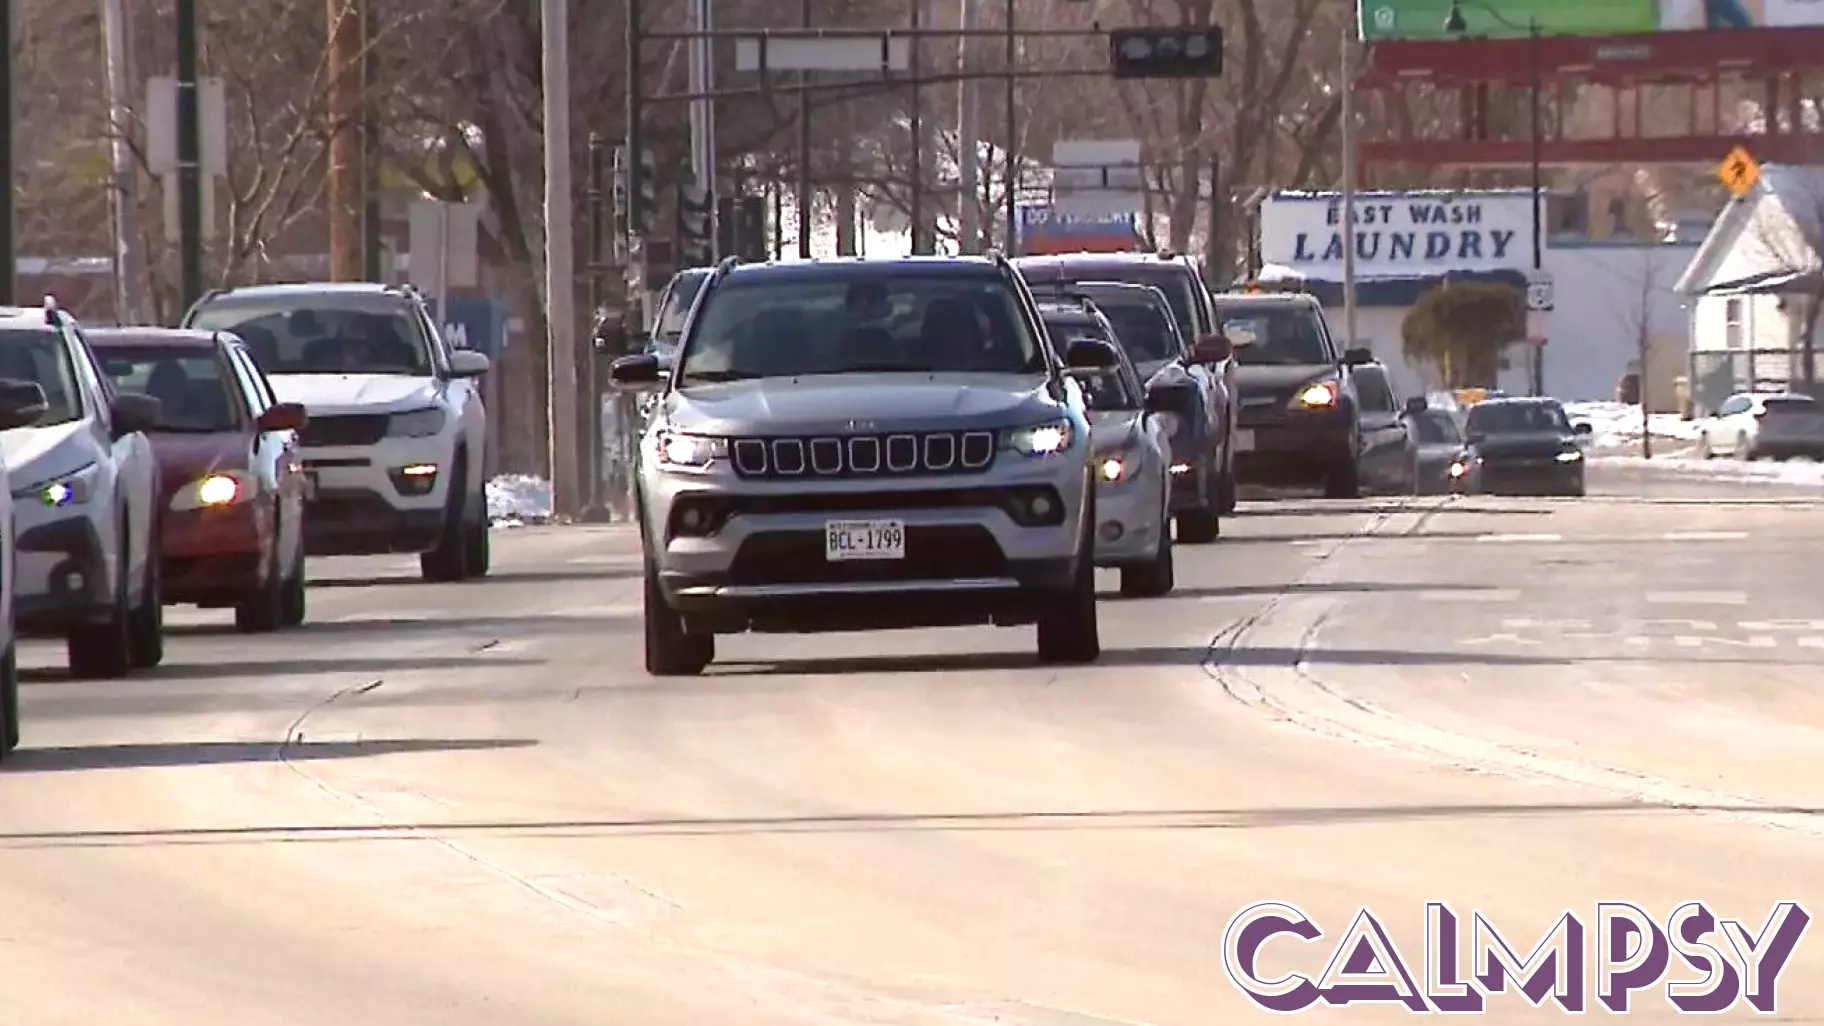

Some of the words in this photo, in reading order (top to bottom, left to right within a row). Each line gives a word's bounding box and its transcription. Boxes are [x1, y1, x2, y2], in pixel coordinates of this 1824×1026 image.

[1409, 204, 1482, 225] WASH
[1293, 229, 1515, 261] LAUNDRY
[829, 528, 902, 552] BCL-1799
